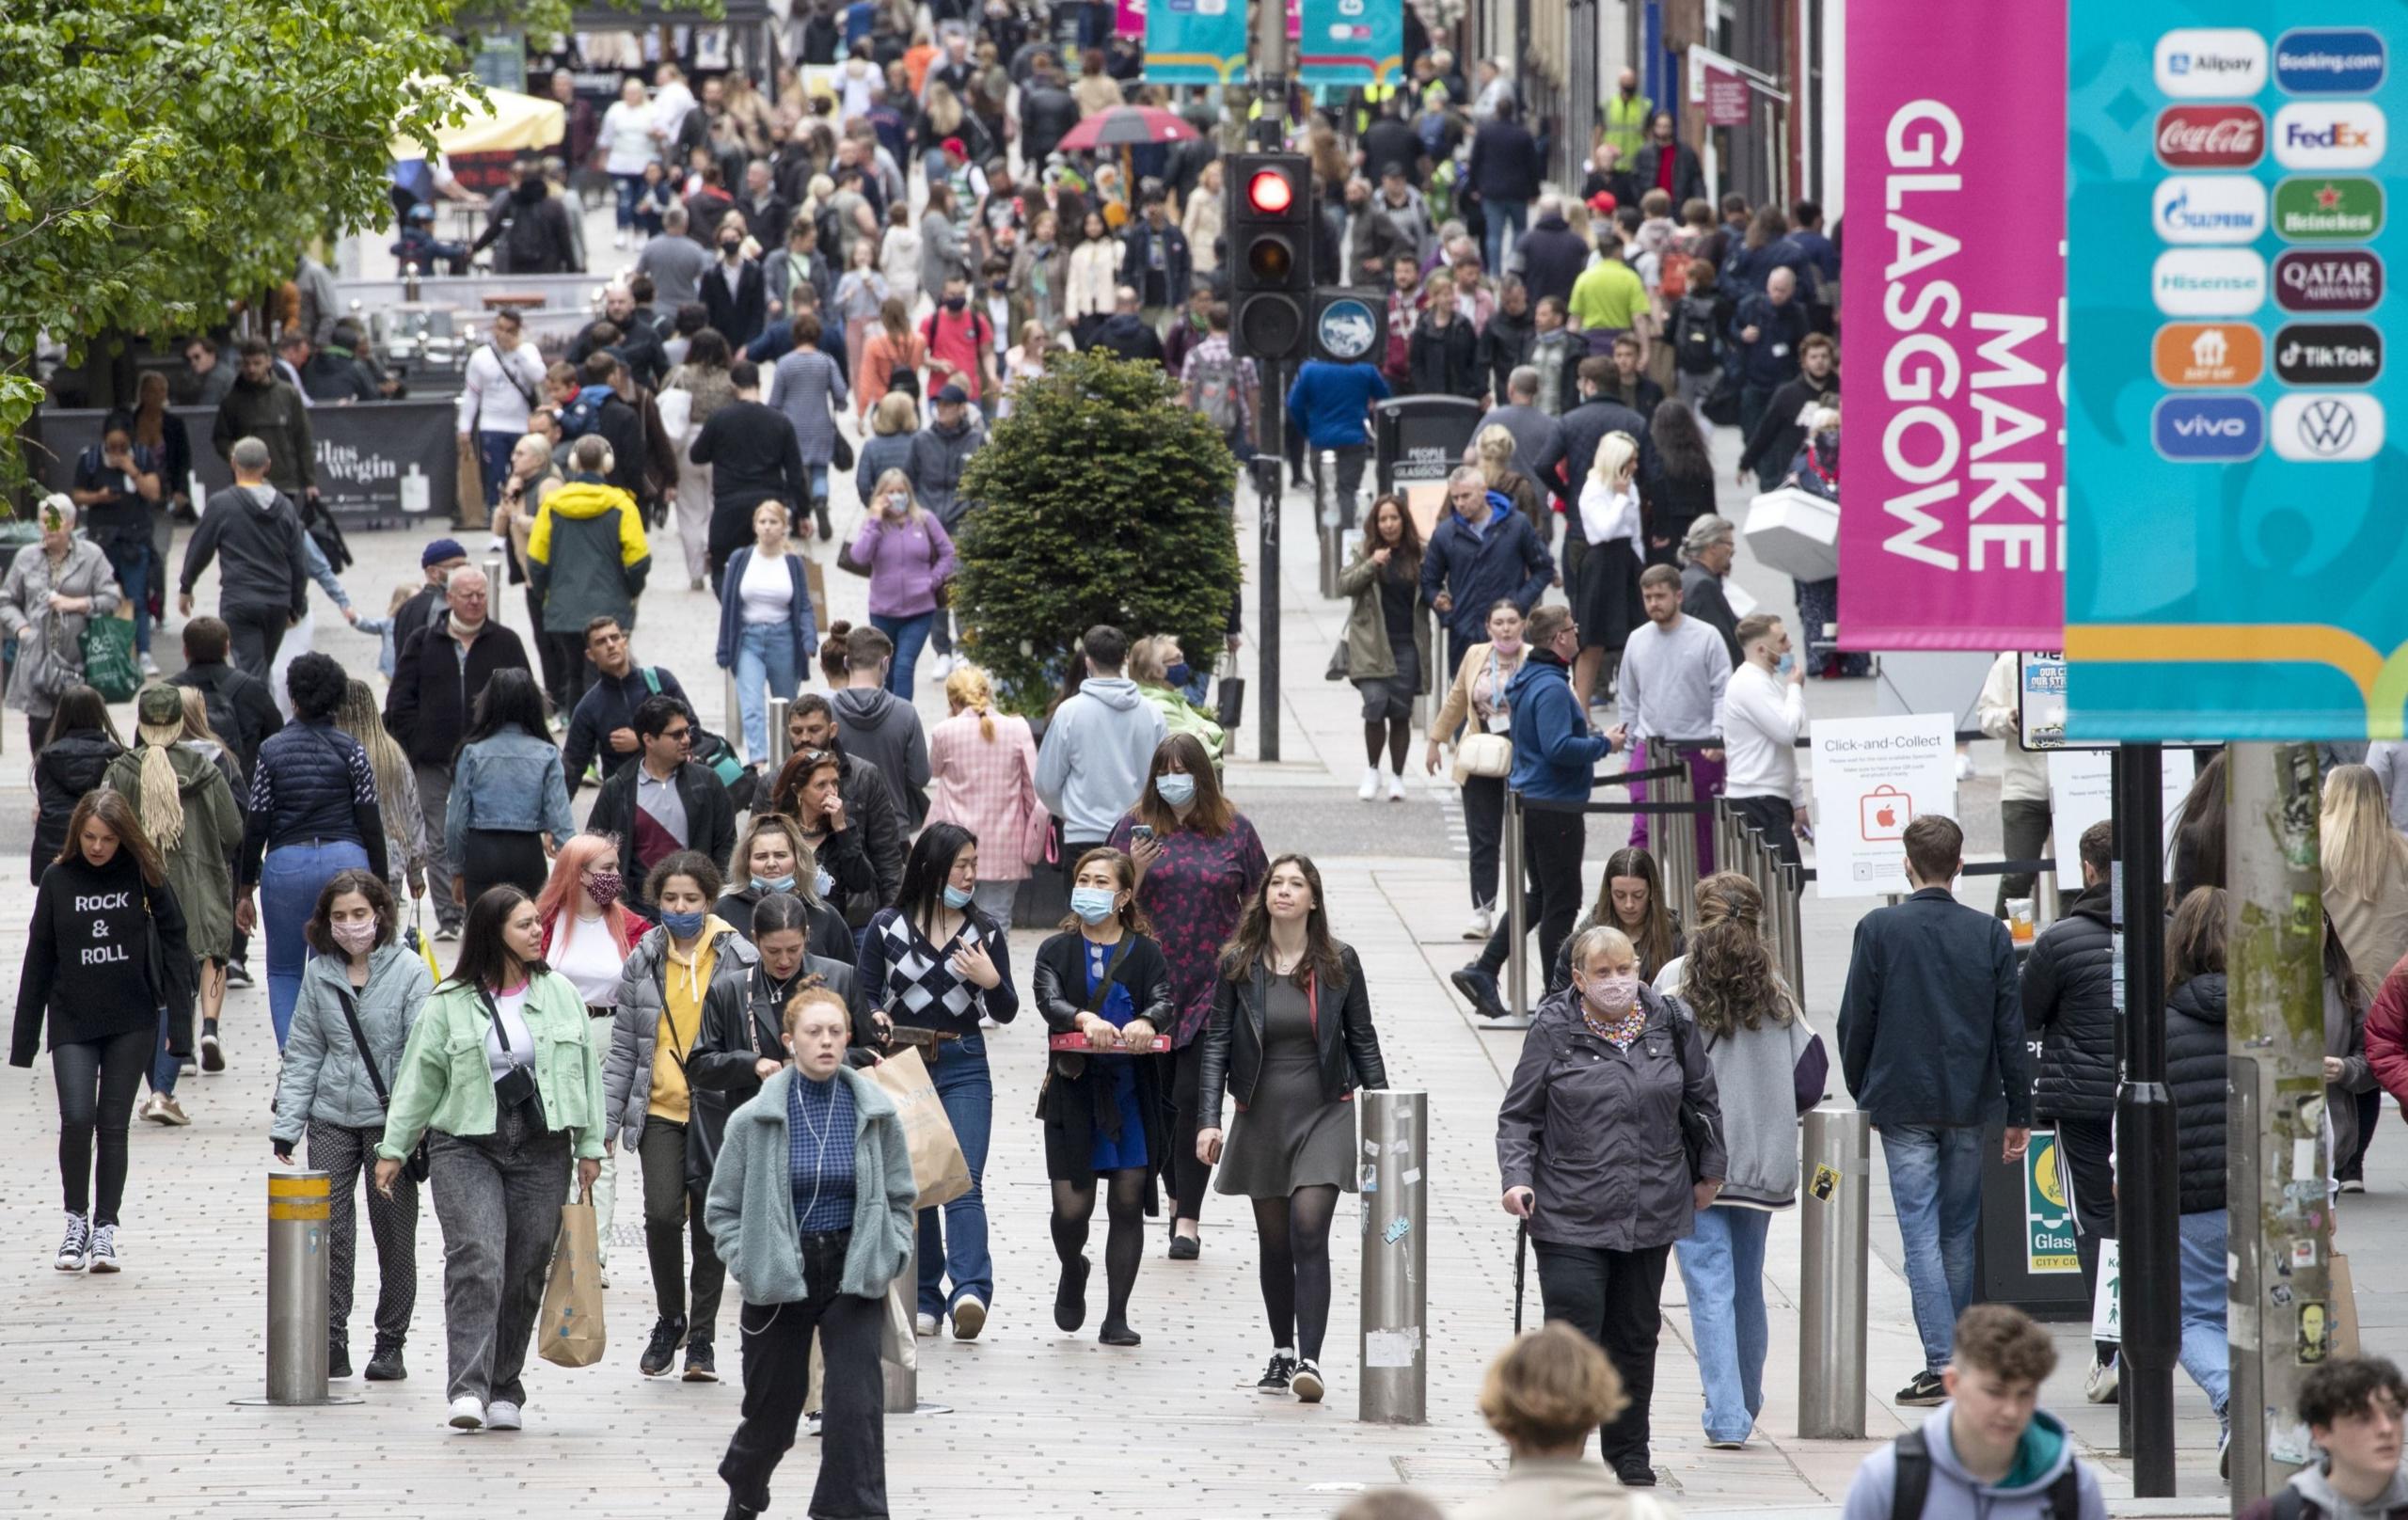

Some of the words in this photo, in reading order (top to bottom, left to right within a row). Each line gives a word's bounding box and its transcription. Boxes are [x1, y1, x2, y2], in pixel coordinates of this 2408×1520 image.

[2194, 55, 2253, 73] Alipay
[2278, 52, 2382, 73] Booking.com
[2287, 122, 2369, 148] FedEx
[2285, 211, 2372, 231] Heineken
[2161, 274, 2257, 290] Hisense
[2283, 261, 2372, 291] QATAR
[2305, 286, 2374, 300] AIRWAYS
[1882, 99, 1964, 572] GLASGOW
[2305, 346, 2376, 366] TikTok
[2173, 415, 2246, 436] vivo
[1969, 312, 2049, 572] MAKE
[1394, 466, 1447, 478] GLASGOW
[1825, 735, 1941, 752] Click-and-Collect
[75, 892, 129, 912] ROCK
[92, 919, 109, 938] &
[81, 944, 130, 965] ROLL
[2036, 1258, 2059, 1267] CITY
